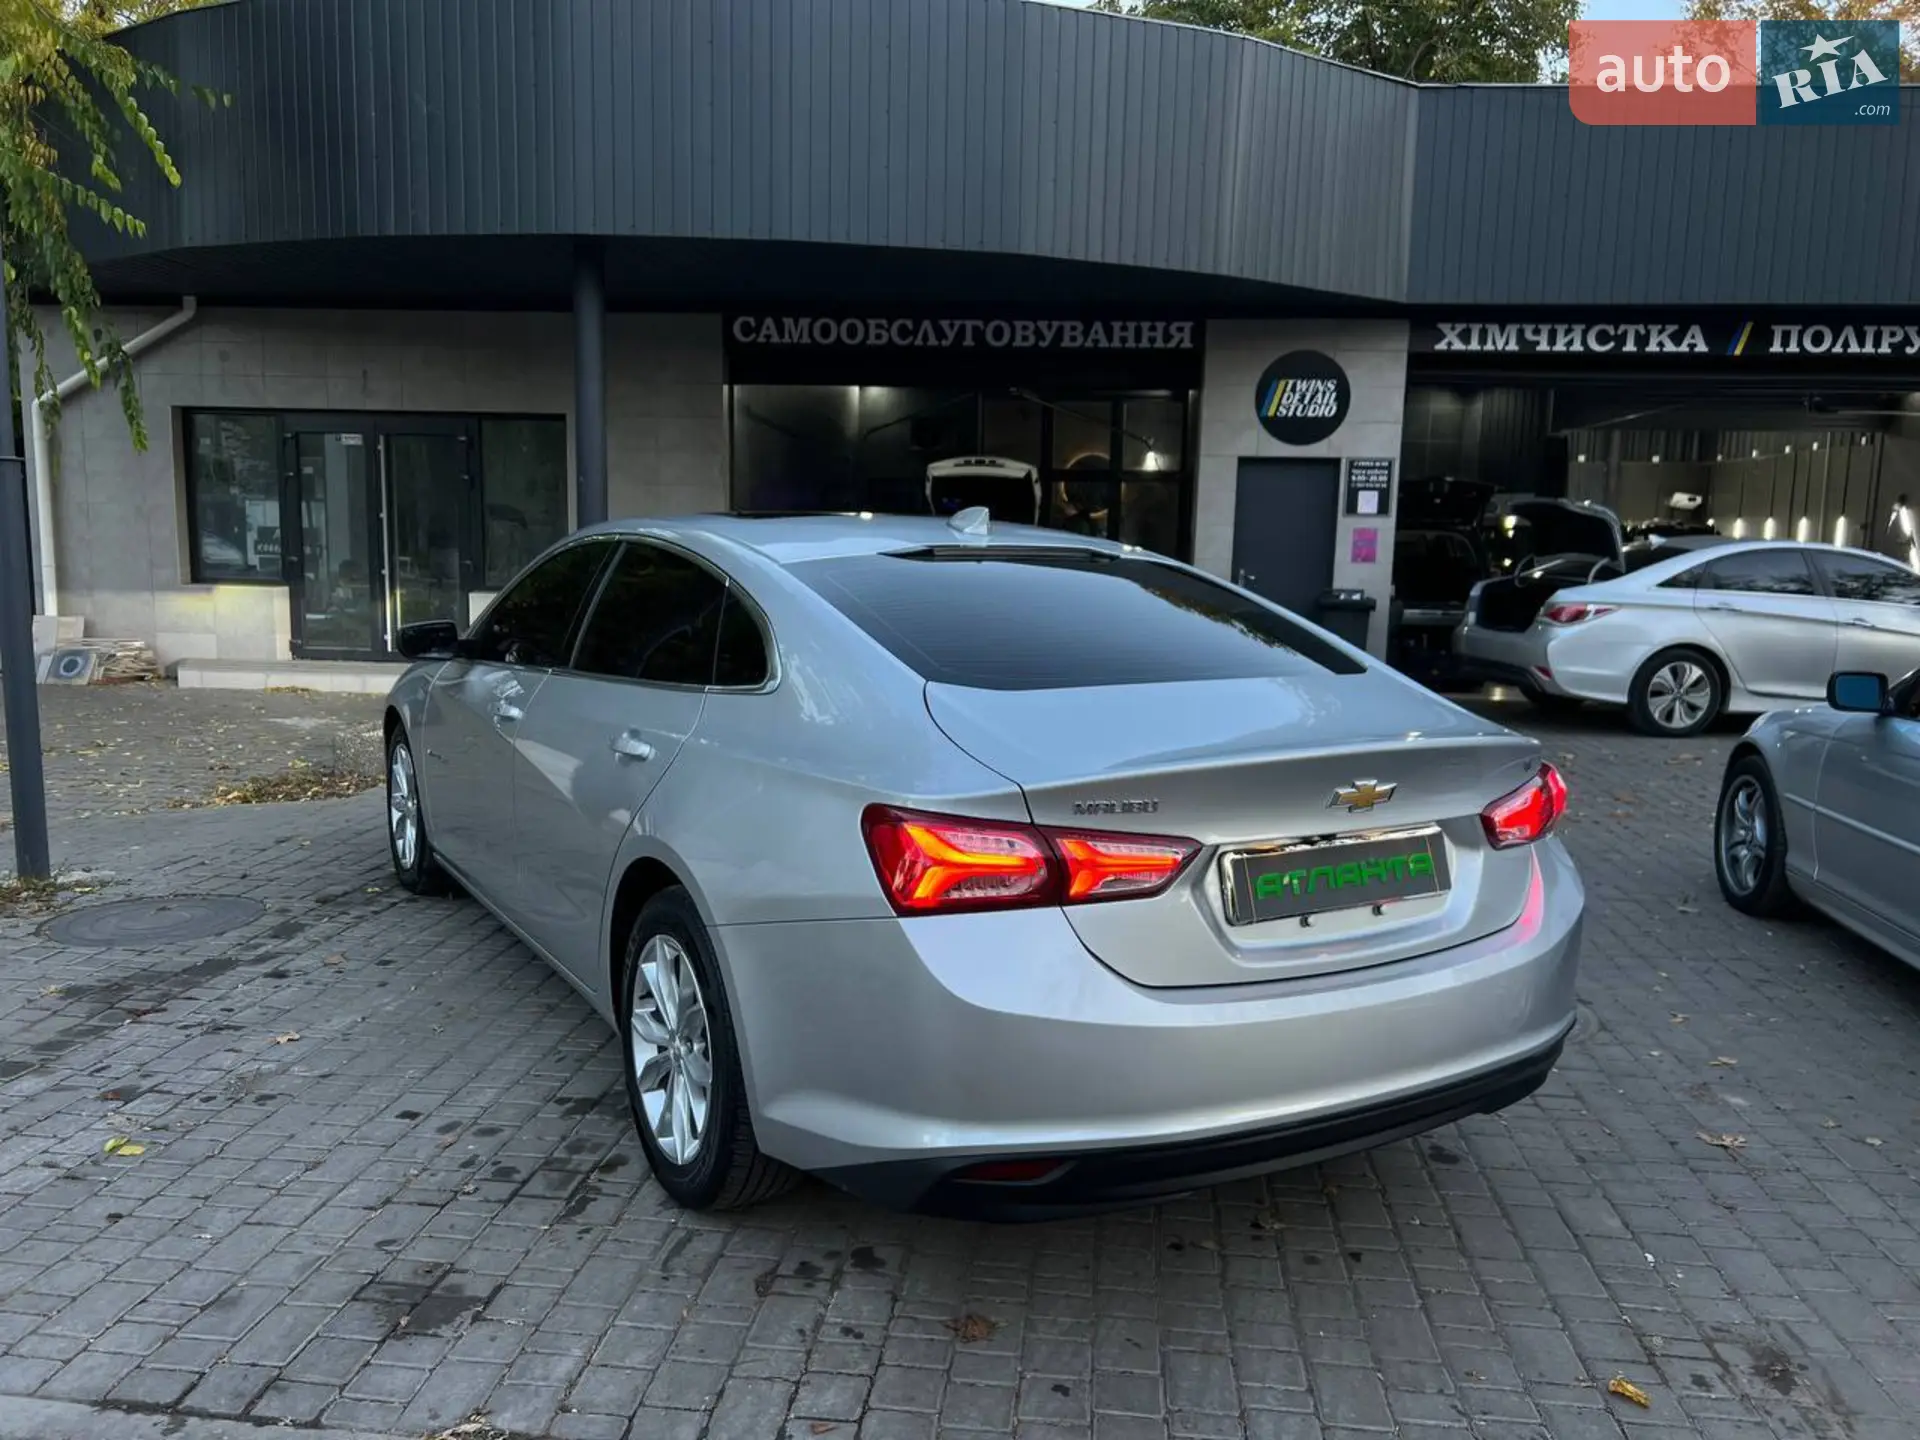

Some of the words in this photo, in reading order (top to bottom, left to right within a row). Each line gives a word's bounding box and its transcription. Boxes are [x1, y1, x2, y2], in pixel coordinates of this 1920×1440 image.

[732, 316, 1194, 349] САМООБСЛУГОВУВАННЯ
[1434, 322, 1709, 353] ХІМЧИСТКА
[1285, 379, 1338, 393] TWINS
[1281, 391, 1338, 406] DETAIL
[1276, 403, 1338, 418] STUDIO
[1073, 799, 1159, 815] MALIBU
